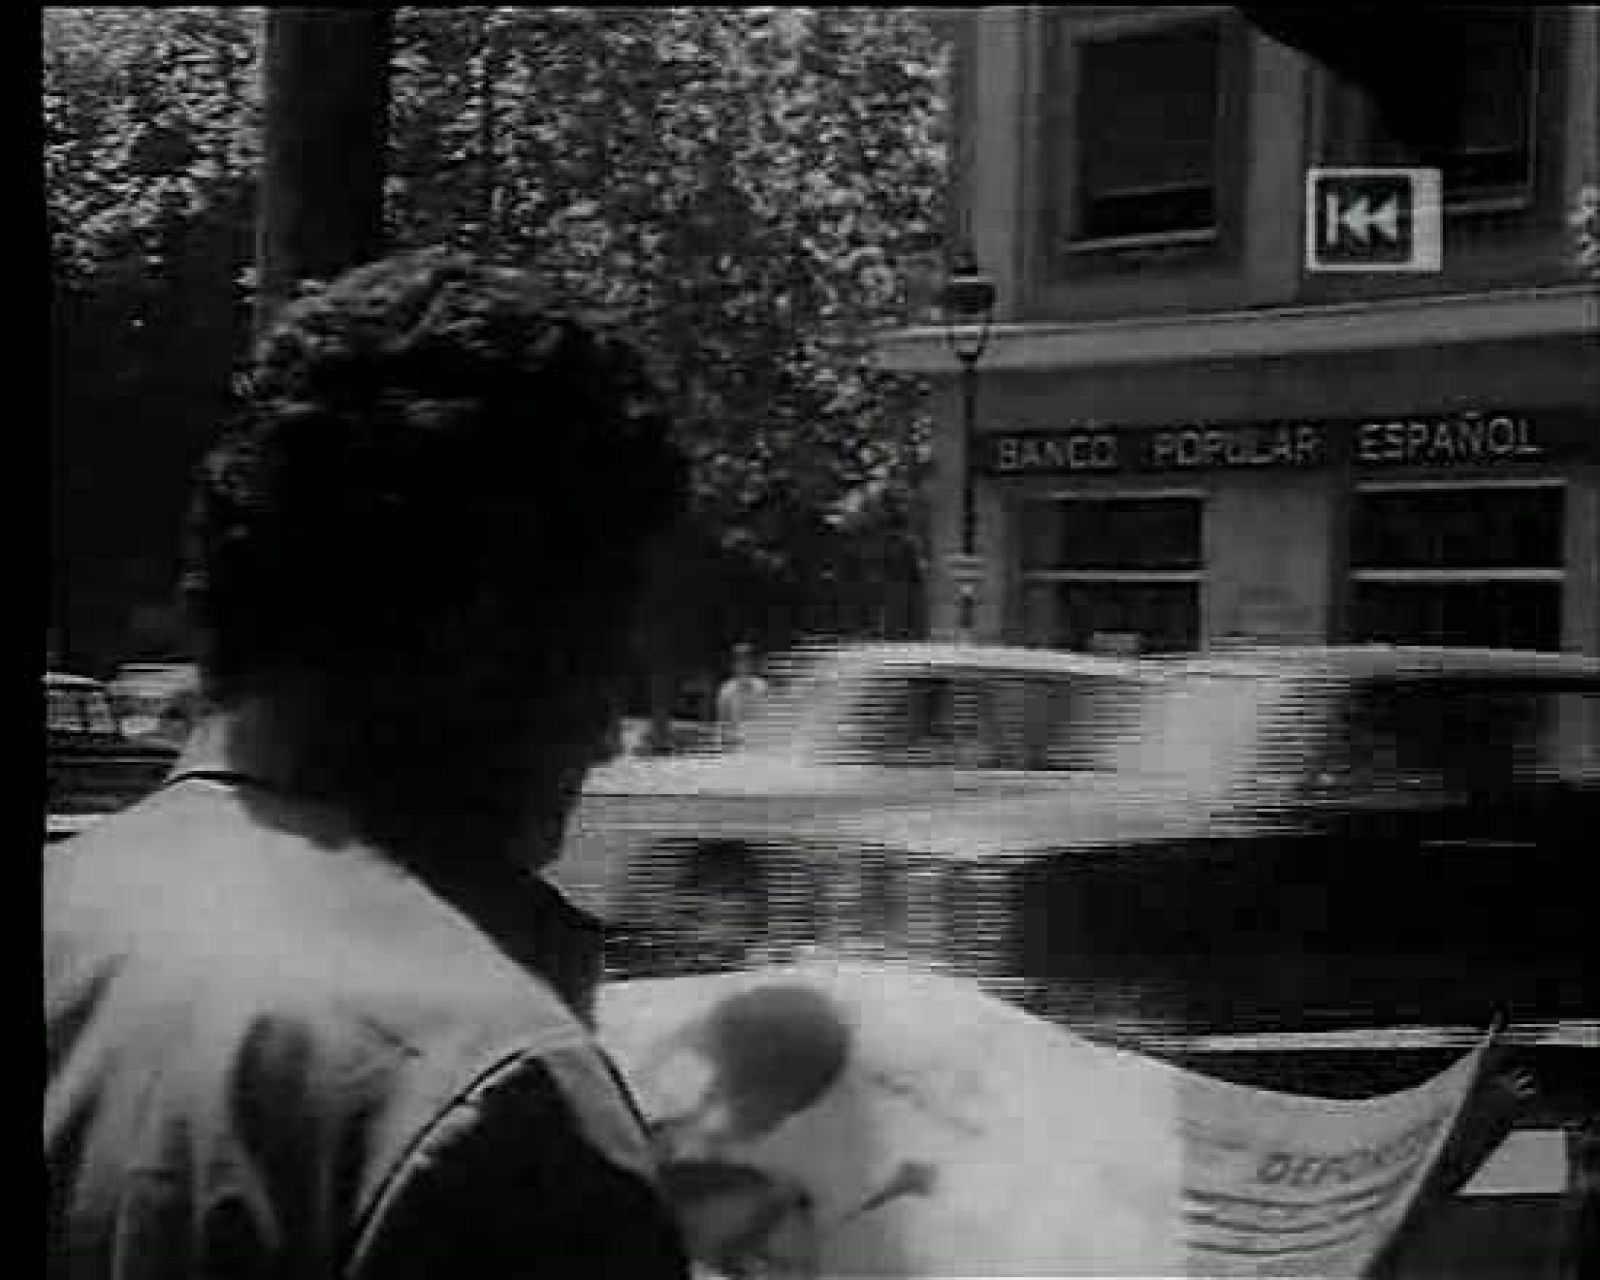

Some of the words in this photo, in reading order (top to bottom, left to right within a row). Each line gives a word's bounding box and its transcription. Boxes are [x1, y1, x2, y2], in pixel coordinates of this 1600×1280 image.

[998, 436, 1120, 470] BANCO
[1152, 426, 1322, 466] POPULAR
[1358, 411, 1539, 461] ESPAÑOL
